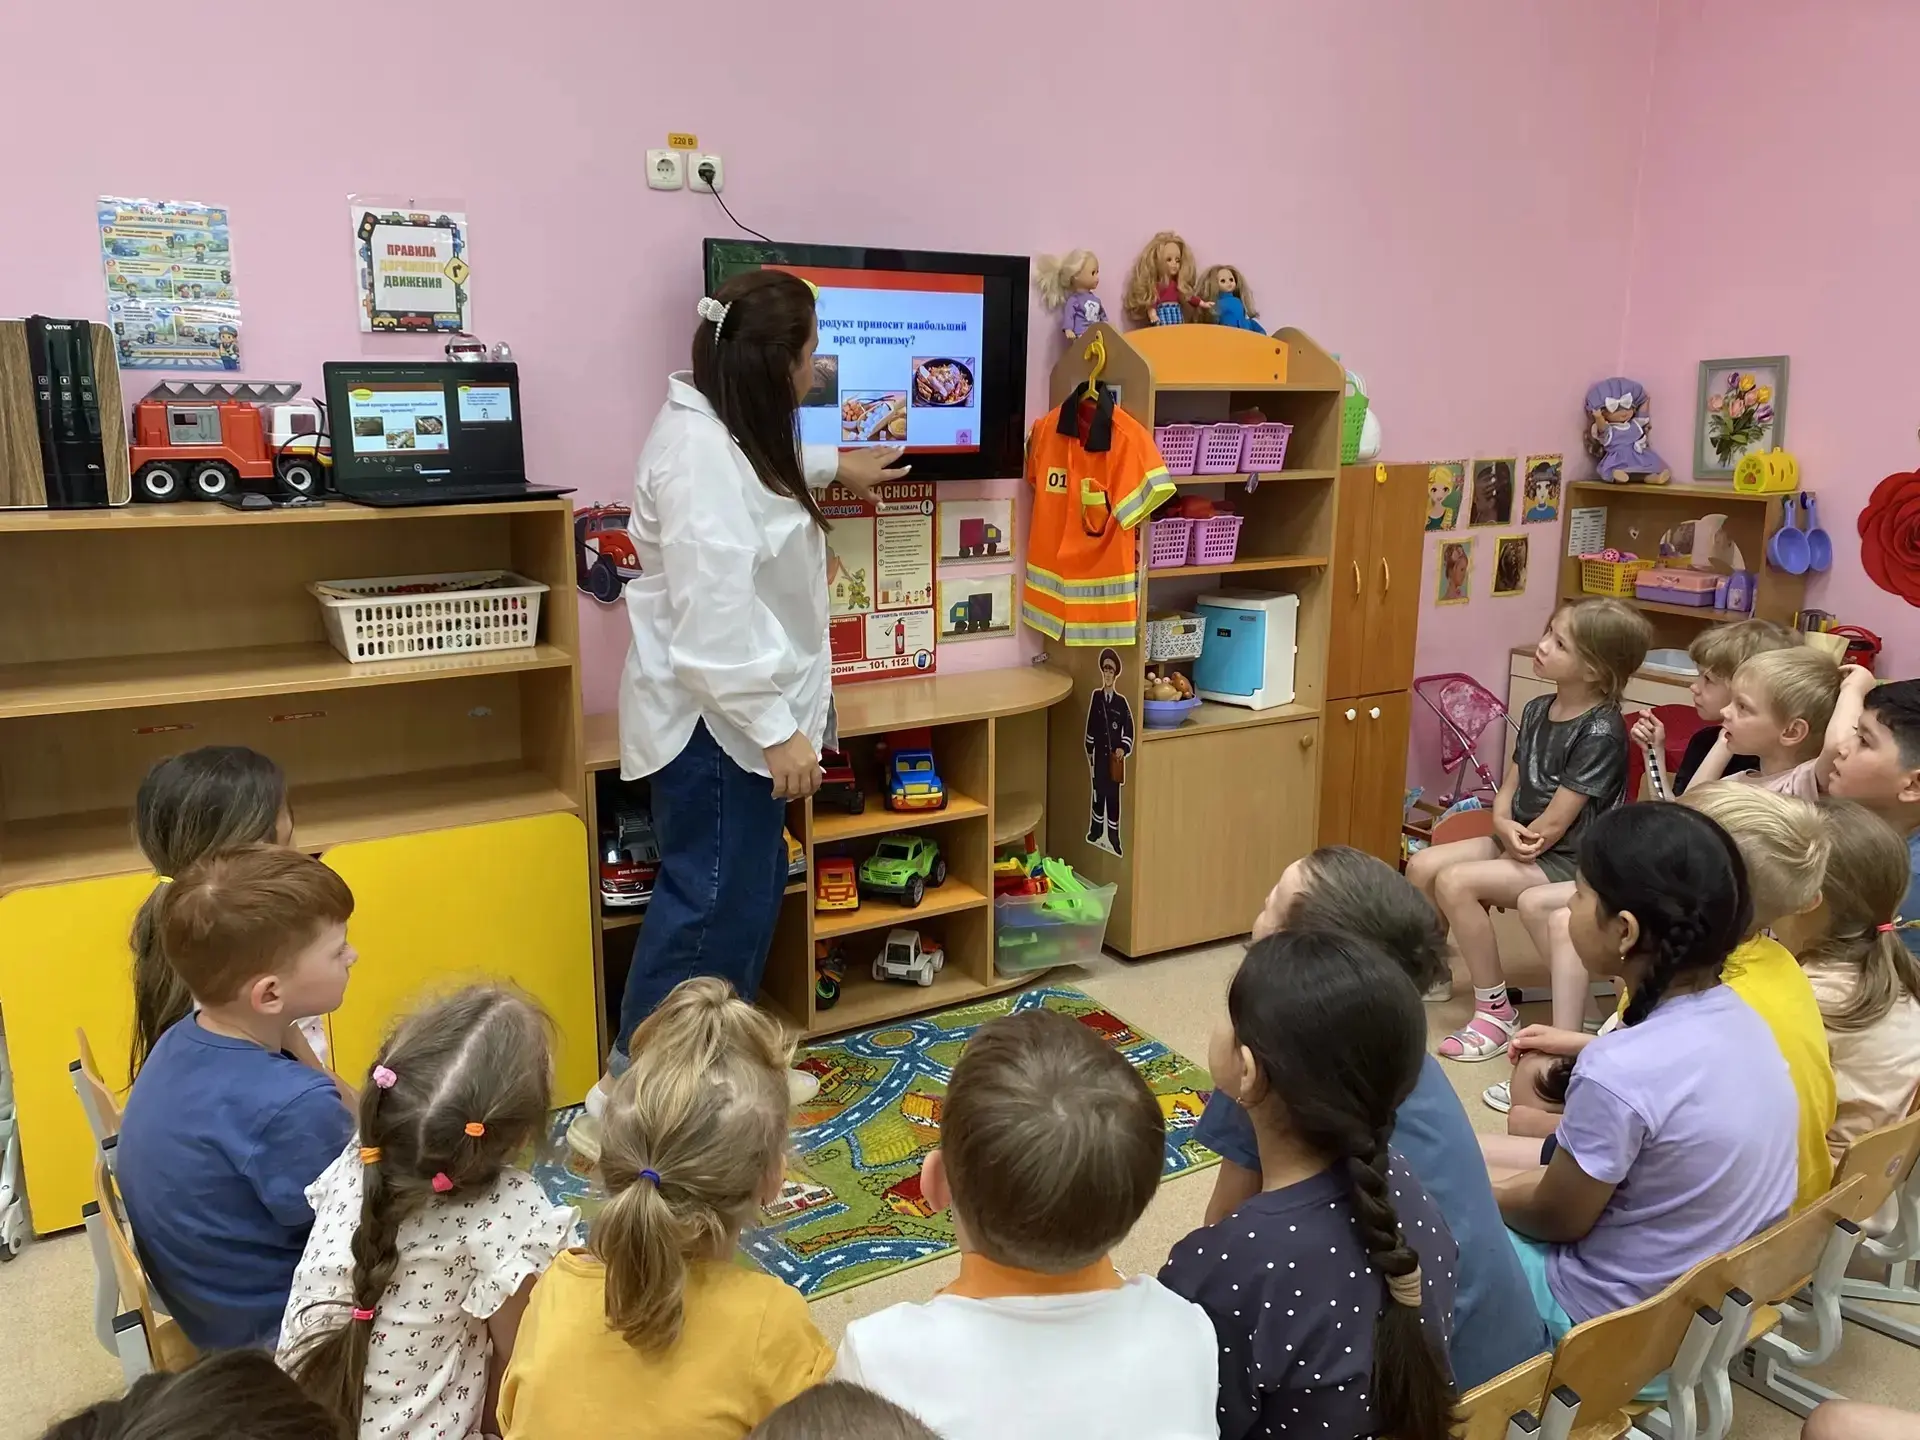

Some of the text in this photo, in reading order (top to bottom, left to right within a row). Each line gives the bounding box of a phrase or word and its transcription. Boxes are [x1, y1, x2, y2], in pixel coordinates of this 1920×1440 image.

[387, 244, 436, 258] ПРАВИЛА
[383, 275, 442, 288] ДВИЖЕНИЯ
[818, 319, 967, 332] родукт приносит наибольший
[833, 335, 916, 348] вред организму?
[1048, 472, 1068, 488] 01
[832, 484, 932, 501] БЕЗАСНОСТИ
[891, 657, 909, 667] 112!
